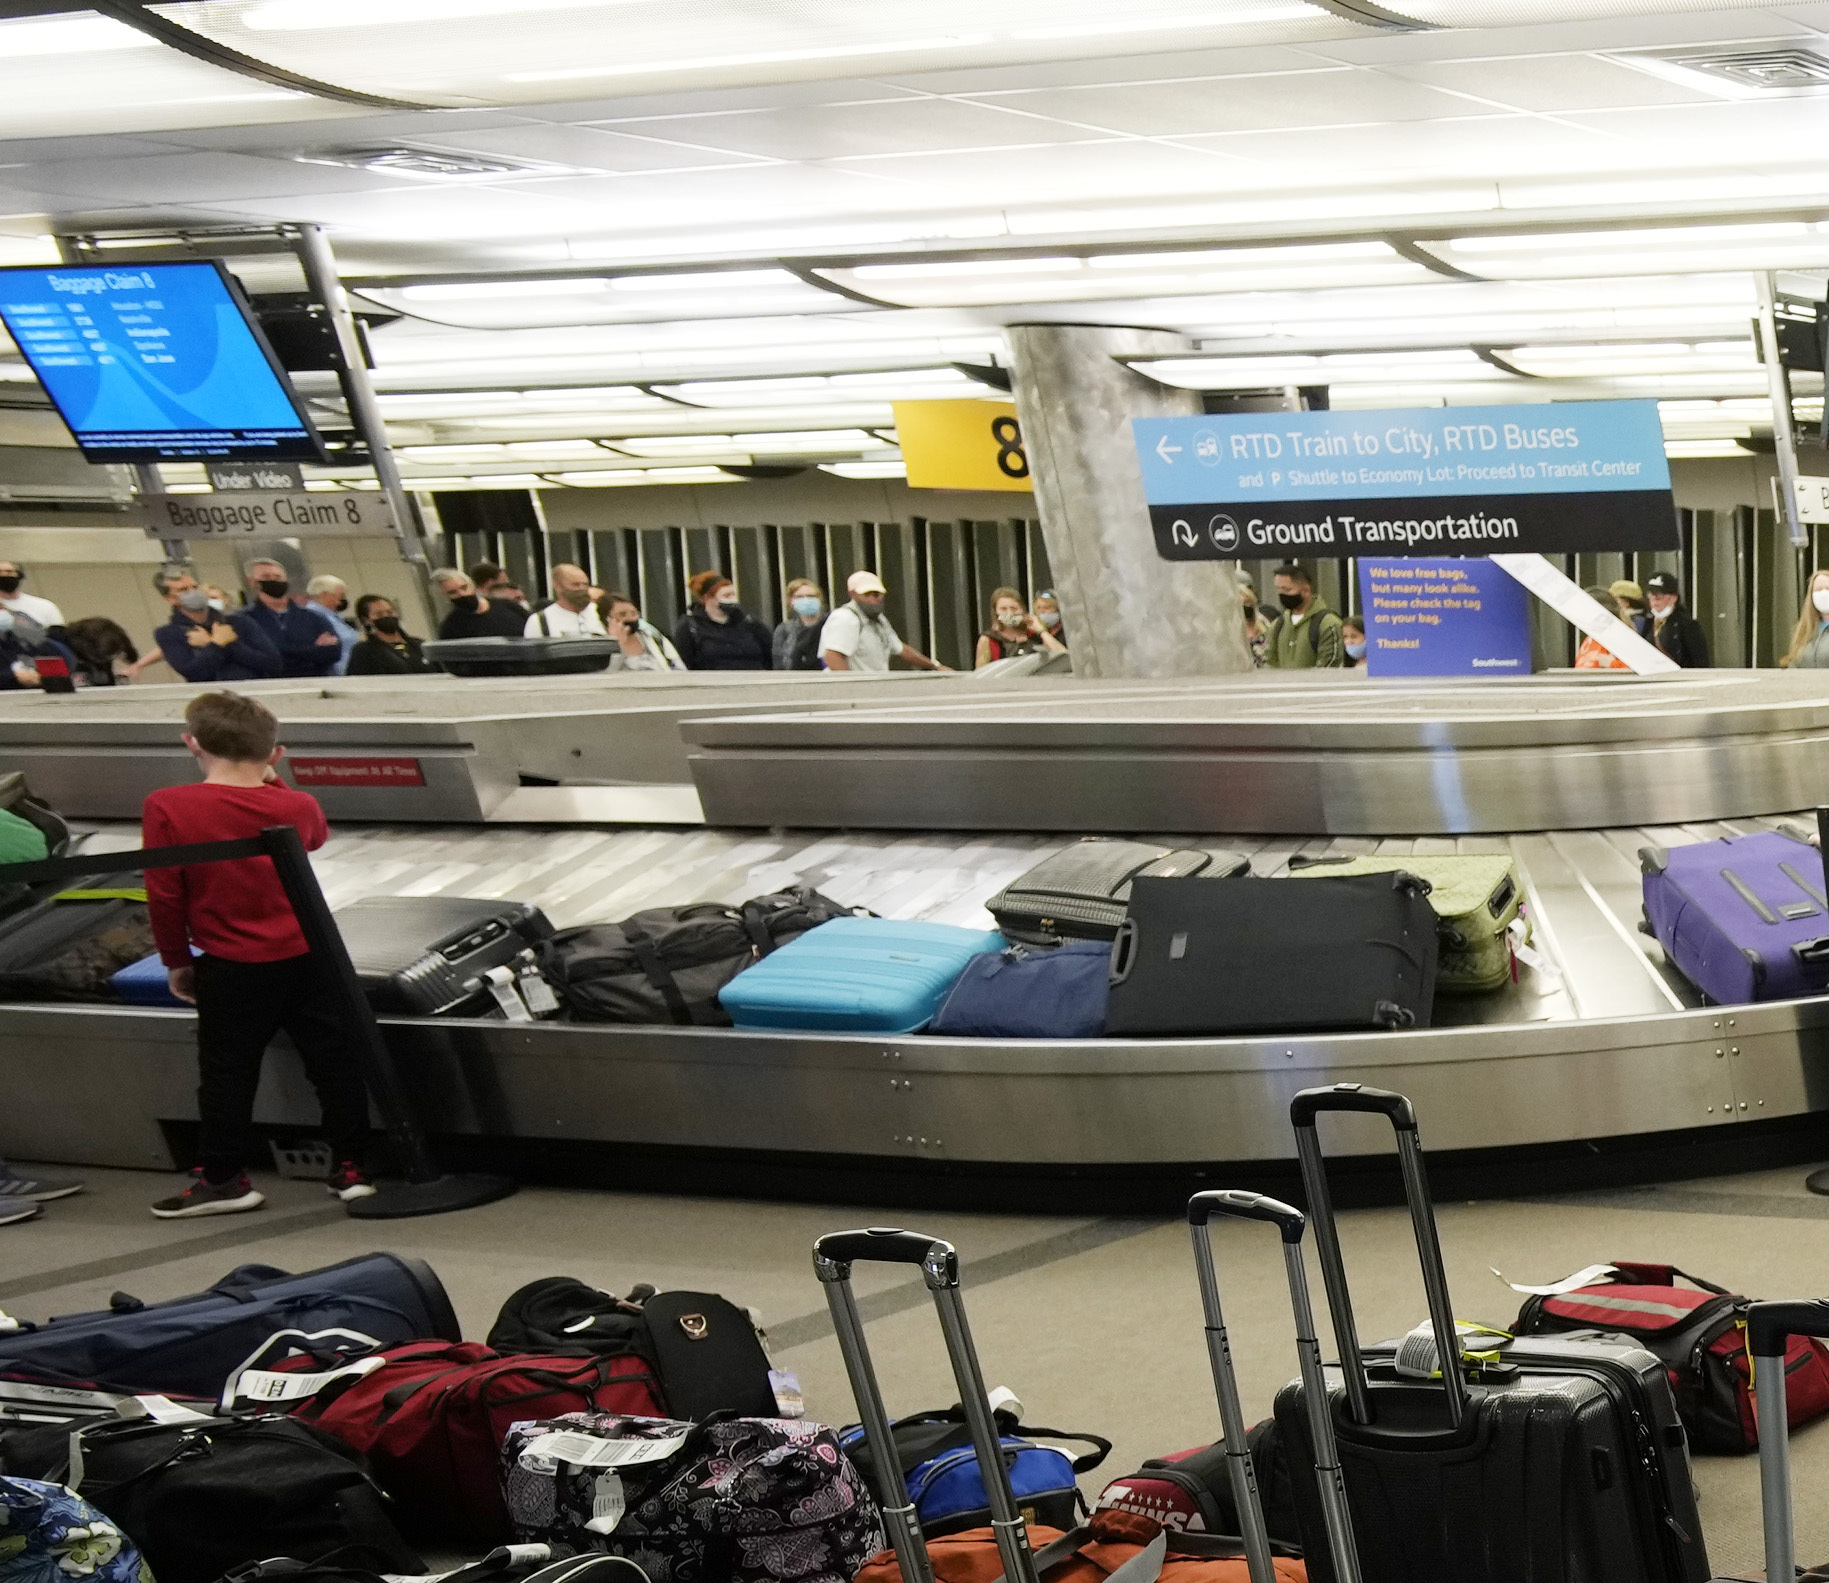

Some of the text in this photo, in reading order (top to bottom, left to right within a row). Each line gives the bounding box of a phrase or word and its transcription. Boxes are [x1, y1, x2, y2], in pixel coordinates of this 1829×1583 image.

[46, 274, 108, 295] Baggage
[991, 416, 1029, 478] 8
[1230, 423, 1580, 460] RTD Train to City, RTD Buses
[211, 469, 294, 490] Under Video
[1238, 471, 1264, 488] and
[1287, 468, 1339, 487] Shuttle
[1340, 469, 1356, 484] to
[1359, 465, 1424, 486] Economy
[1457, 462, 1517, 481] Proceed
[1518, 464, 1536, 479] to
[1538, 460, 1589, 478] Transit
[1590, 458, 1642, 477] Center
[165, 498, 361, 532] Baggage Claim 8
[1247, 512, 1519, 546] Ground Transportation
[1369, 567, 1388, 579] We
[1390, 567, 1414, 579] love
[1415, 567, 1437, 579] free
[1371, 581, 1392, 594] but
[1392, 583, 1423, 597] many
[1424, 581, 1450, 594] look
[1373, 597, 1482, 611] Please check the tag
[1374, 612, 1443, 627] on your bag.
[1376, 637, 1420, 650] Thanks!
[1471, 657, 1519, 668] Southwest
